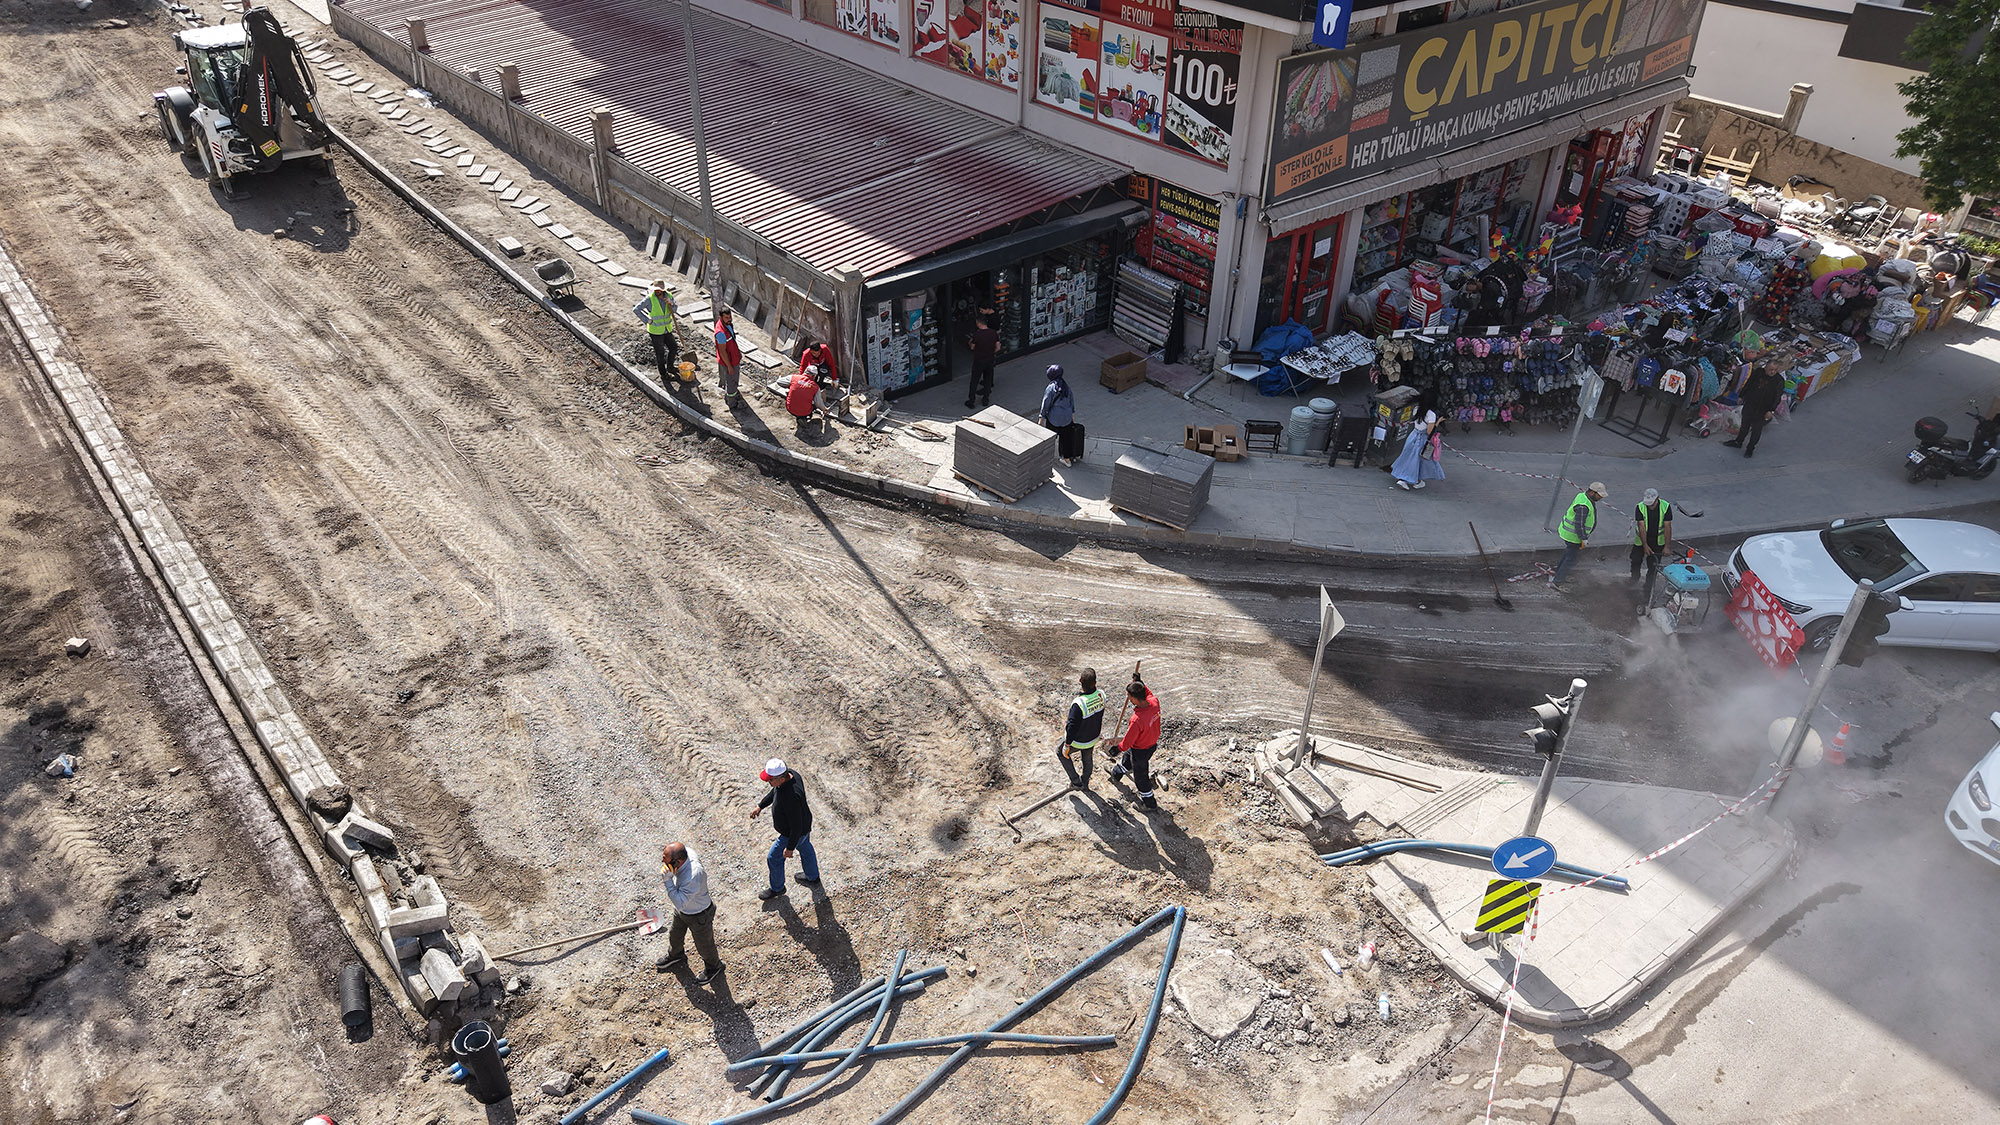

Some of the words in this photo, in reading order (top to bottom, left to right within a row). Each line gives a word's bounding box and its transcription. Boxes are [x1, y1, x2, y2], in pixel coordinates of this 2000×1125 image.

[1120, 4, 1154, 27] REYONU
[1174, 12, 1218, 28] REYONUNDA
[1173, 27, 1190, 50] NE
[1351, 138, 1378, 169] HER
[1381, 121, 1422, 161] TÜRLÜ
[1421, 120, 1459, 149] PARÇA
[1598, 63, 1613, 96] İLE
[1613, 60, 1641, 88] SATIŞ
[1311, 160, 1331, 178] TON
[1161, 186, 1171, 198] HER
[1172, 189, 1188, 204] TÜRLÜ
[1188, 197, 1204, 211] PARÇA
[1205, 203, 1221, 216] KUMA
